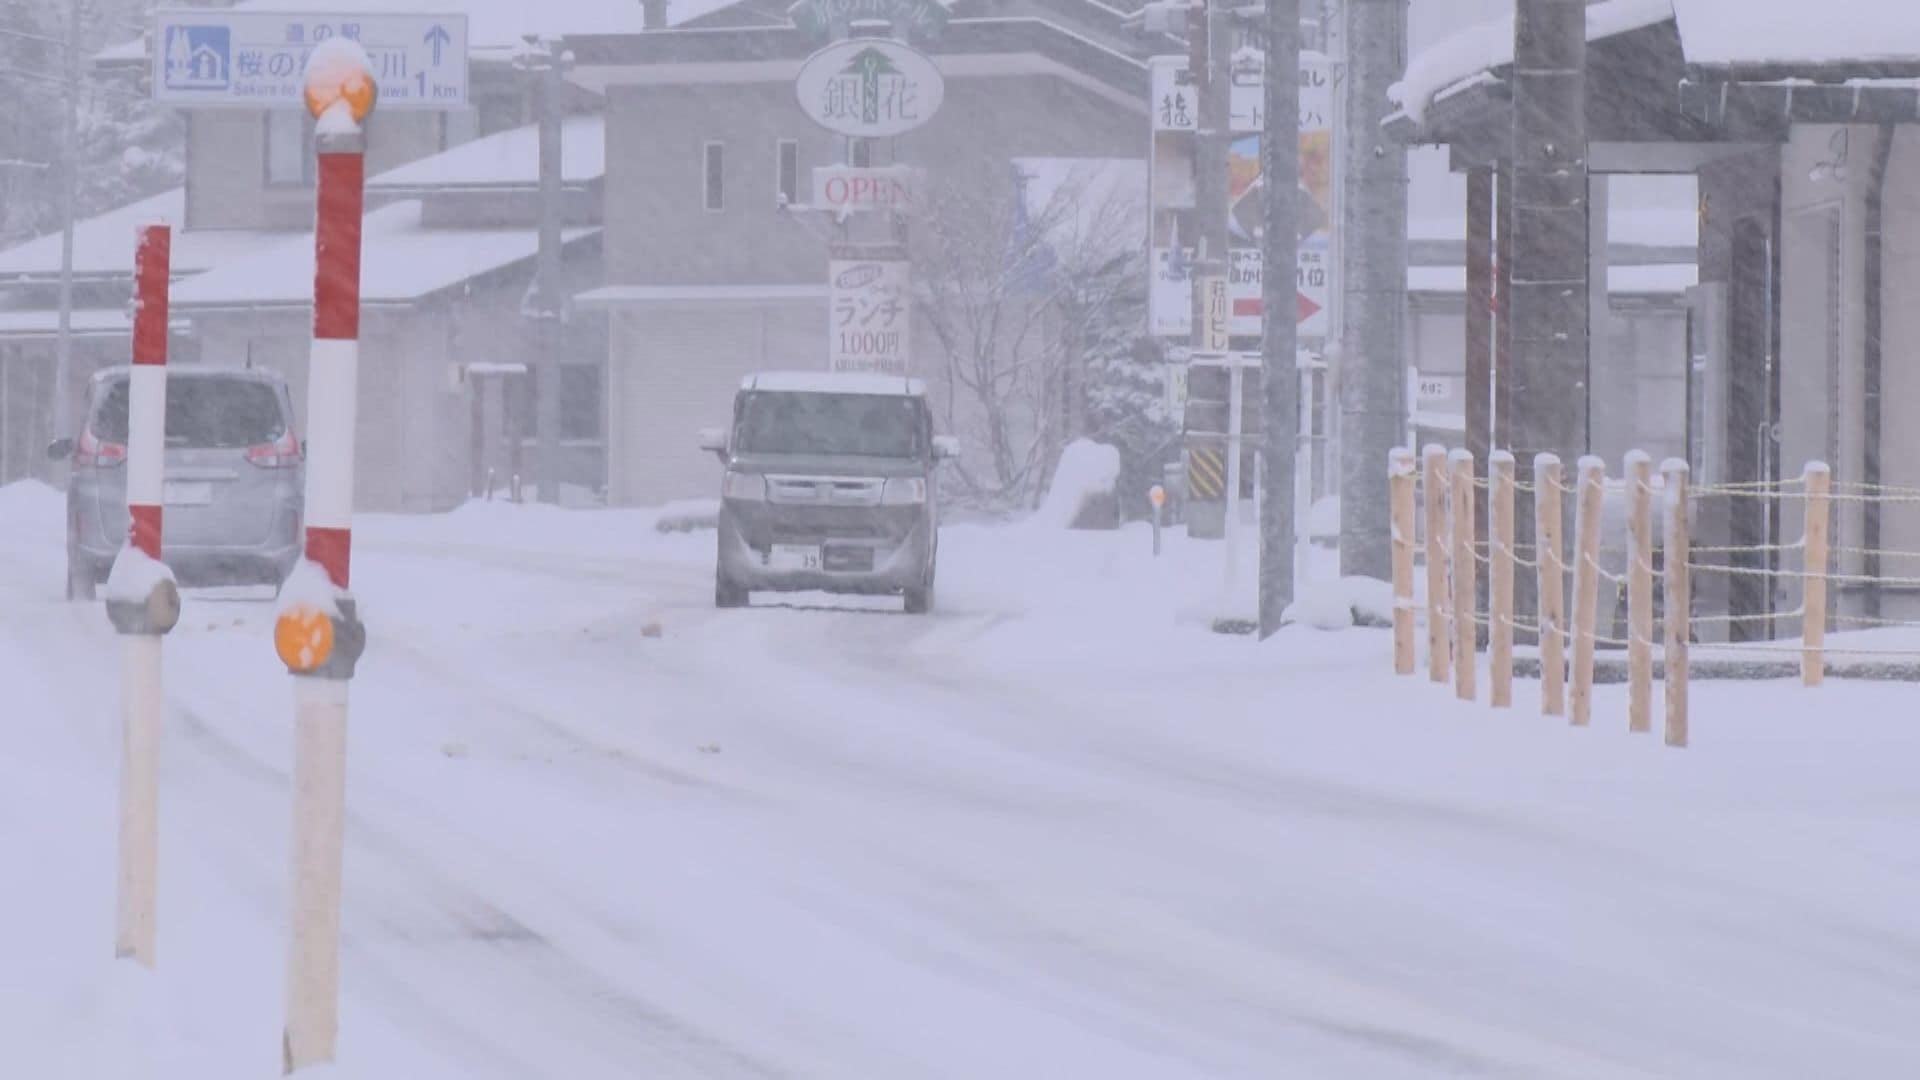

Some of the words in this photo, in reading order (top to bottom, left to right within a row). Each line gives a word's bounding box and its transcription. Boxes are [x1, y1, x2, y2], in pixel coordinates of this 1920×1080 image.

[825, 176, 913, 205] OPEN
[836, 297, 904, 327] ランチ
